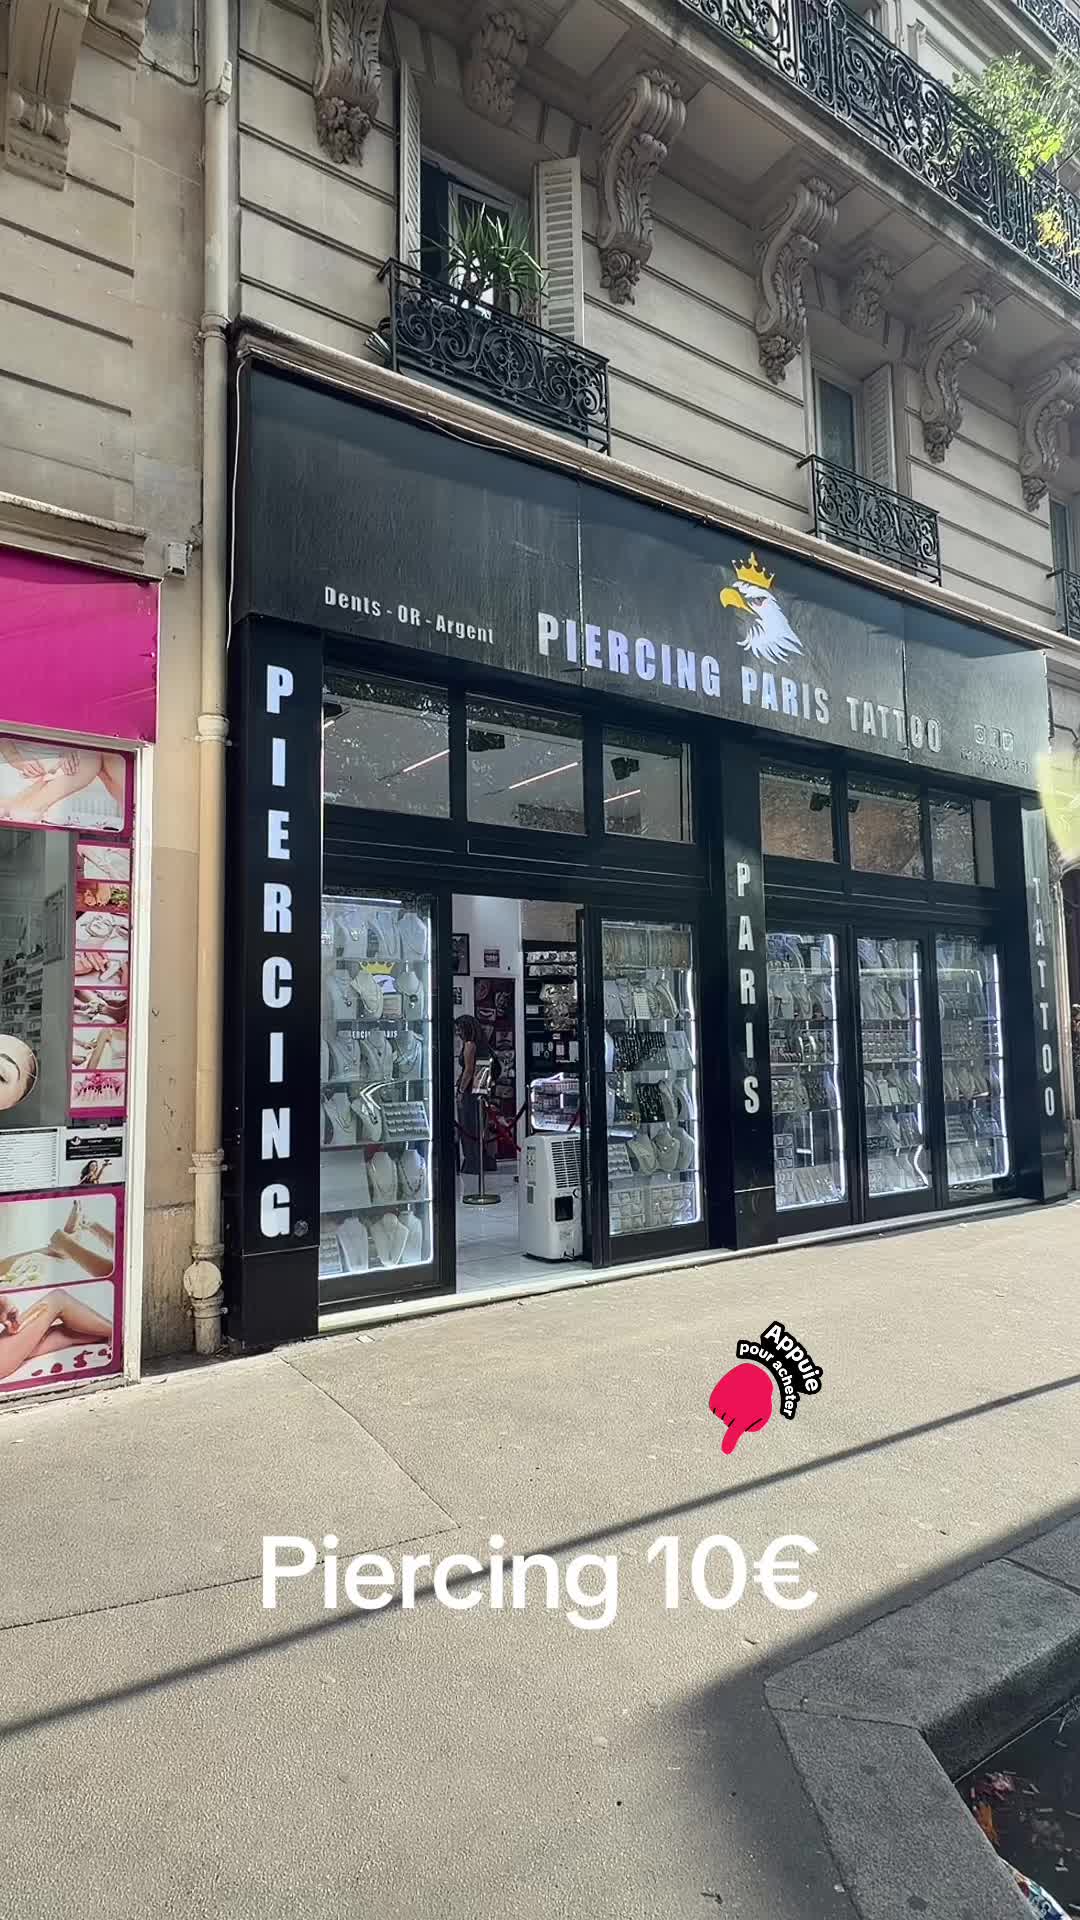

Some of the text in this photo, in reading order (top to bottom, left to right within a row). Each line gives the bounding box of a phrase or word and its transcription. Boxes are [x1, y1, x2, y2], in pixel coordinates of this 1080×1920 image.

[325, 586, 381, 617] Dents
[397, 604, 421, 627] OR
[435, 613, 494, 645] Argent
[538, 611, 942, 753] PIERCING PARIS TATTOO
[260, 664, 294, 1238] PIERCING
[736, 862, 761, 1115] PARIS
[1032, 877, 1055, 1118] TATTOO
